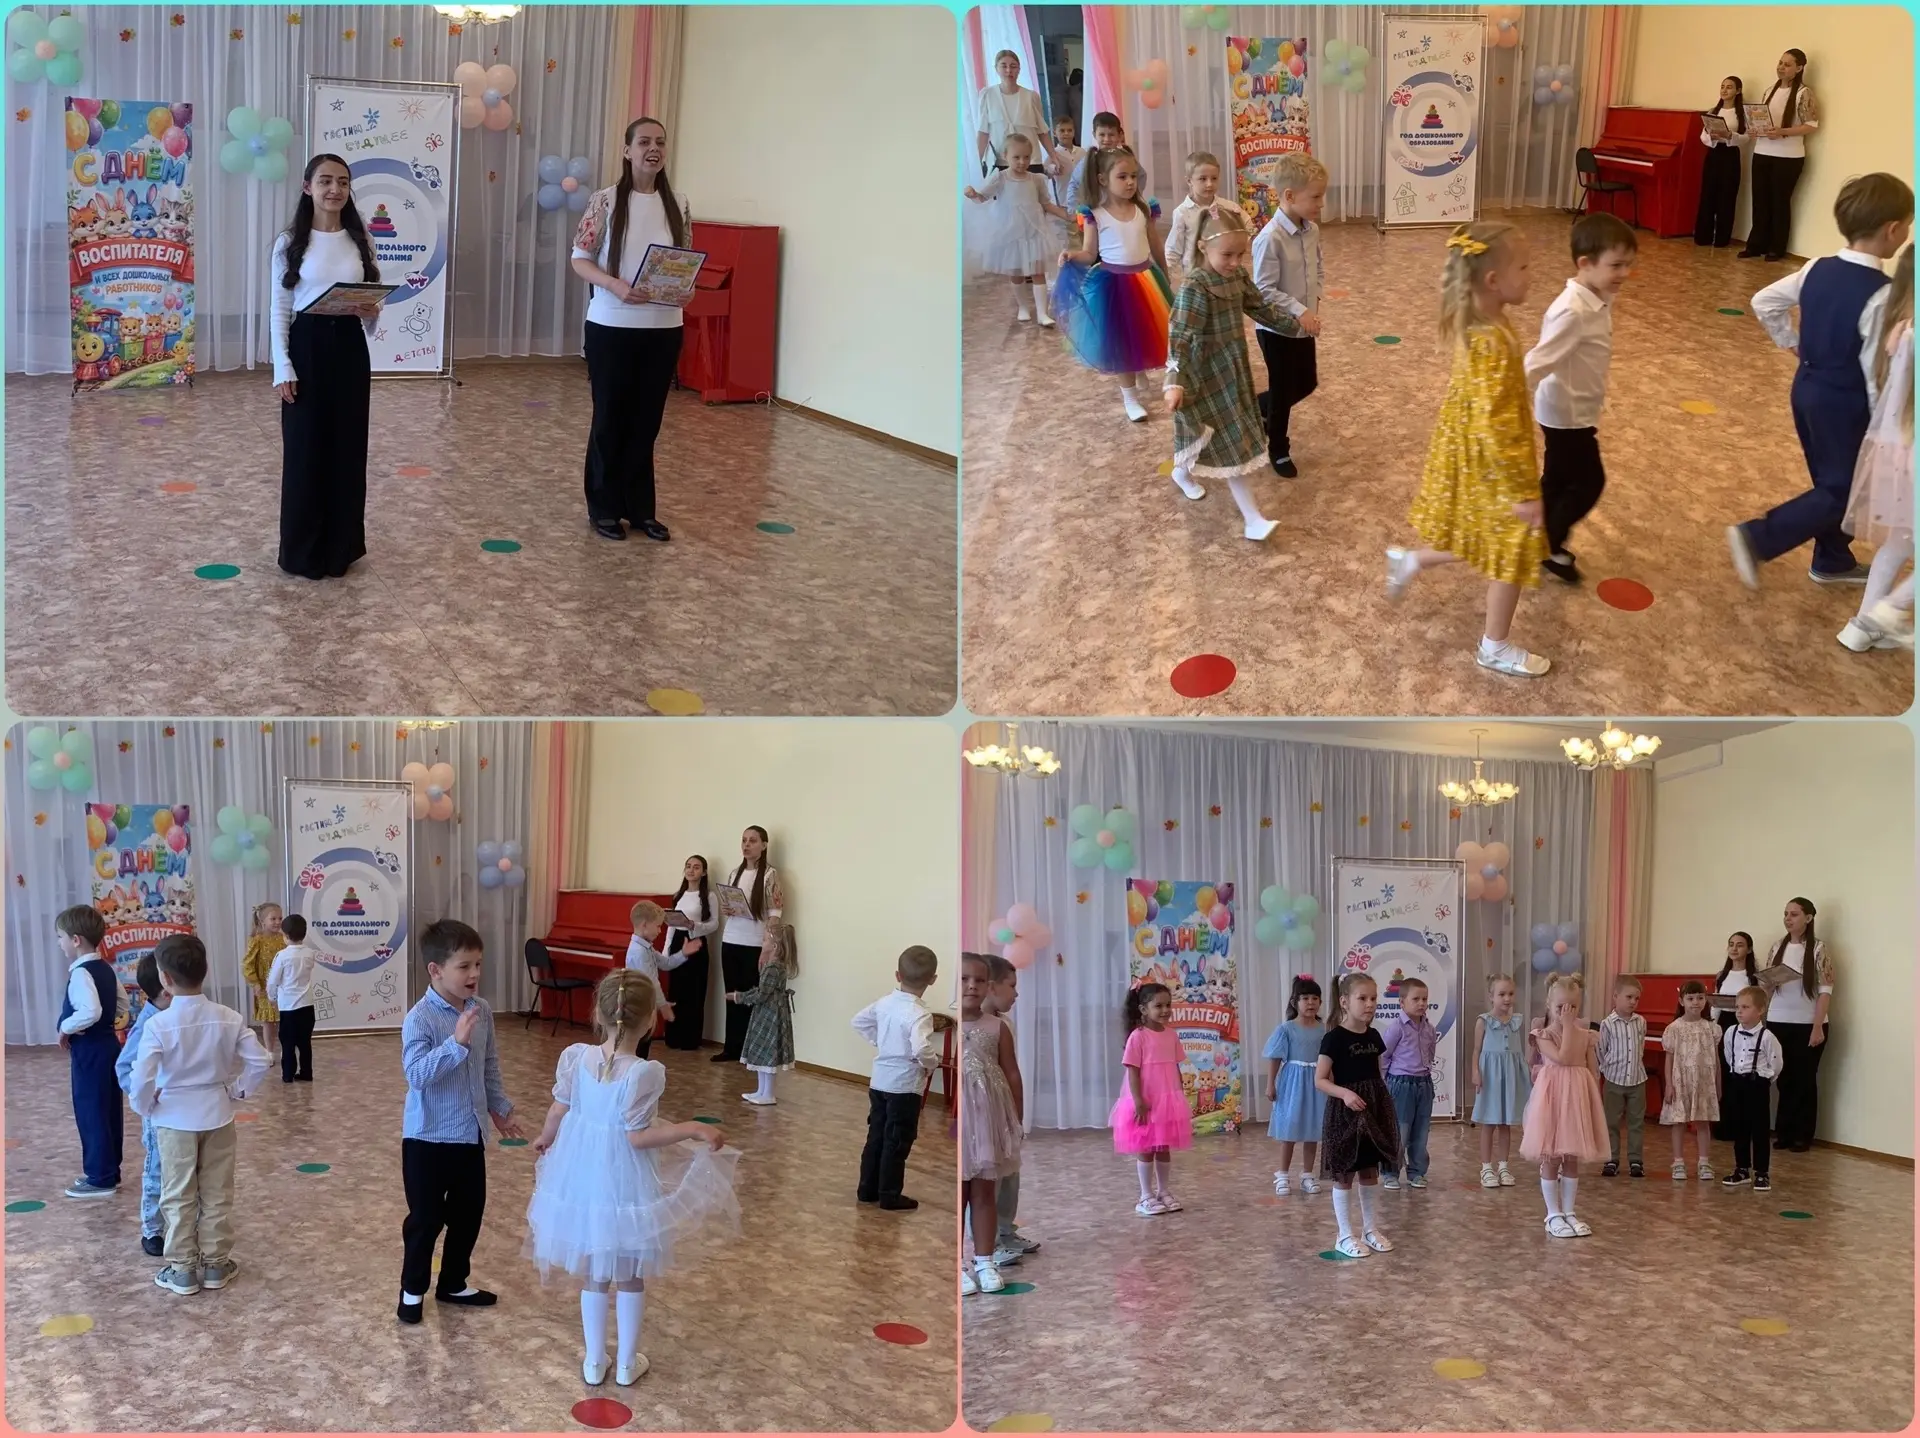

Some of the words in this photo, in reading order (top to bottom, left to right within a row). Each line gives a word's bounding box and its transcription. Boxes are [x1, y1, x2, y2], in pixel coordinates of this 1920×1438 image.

[1234, 75, 1249, 100] С
[1251, 70, 1304, 99] ДНЁМ
[1239, 138, 1305, 155] ВОСПИТАТЕЛЯ
[73, 151, 99, 187] С
[101, 146, 186, 187] ДНЁМ
[79, 242, 185, 268] ВОСПИТАТЕЛЯ
[375, 243, 427, 252] КОЛЬНОГО
[376, 254, 413, 262] ОВАНИЯ
[102, 271, 121, 282] ВСЕХ
[122, 270, 171, 281] ДОШКОЛЬНЫХ
[105, 282, 162, 294] РАБОТНИКОВ
[393, 345, 436, 363] ДЕТСТВО
[95, 851, 117, 880] С
[118, 843, 187, 879] ДНЁМ
[311, 920, 329, 928] ГОД
[330, 920, 391, 928] ДОШКОЛЬНОГО
[1134, 927, 1157, 958] С
[1158, 922, 1230, 957] ДНЁМ
[1168, 1007, 1230, 1027] ПИТАТЕЛЯ
[1178, 1031, 1218, 1042] ДОШКОЛЬНЫХ
[1183, 1042, 1213, 1051] ТНИКОВ
